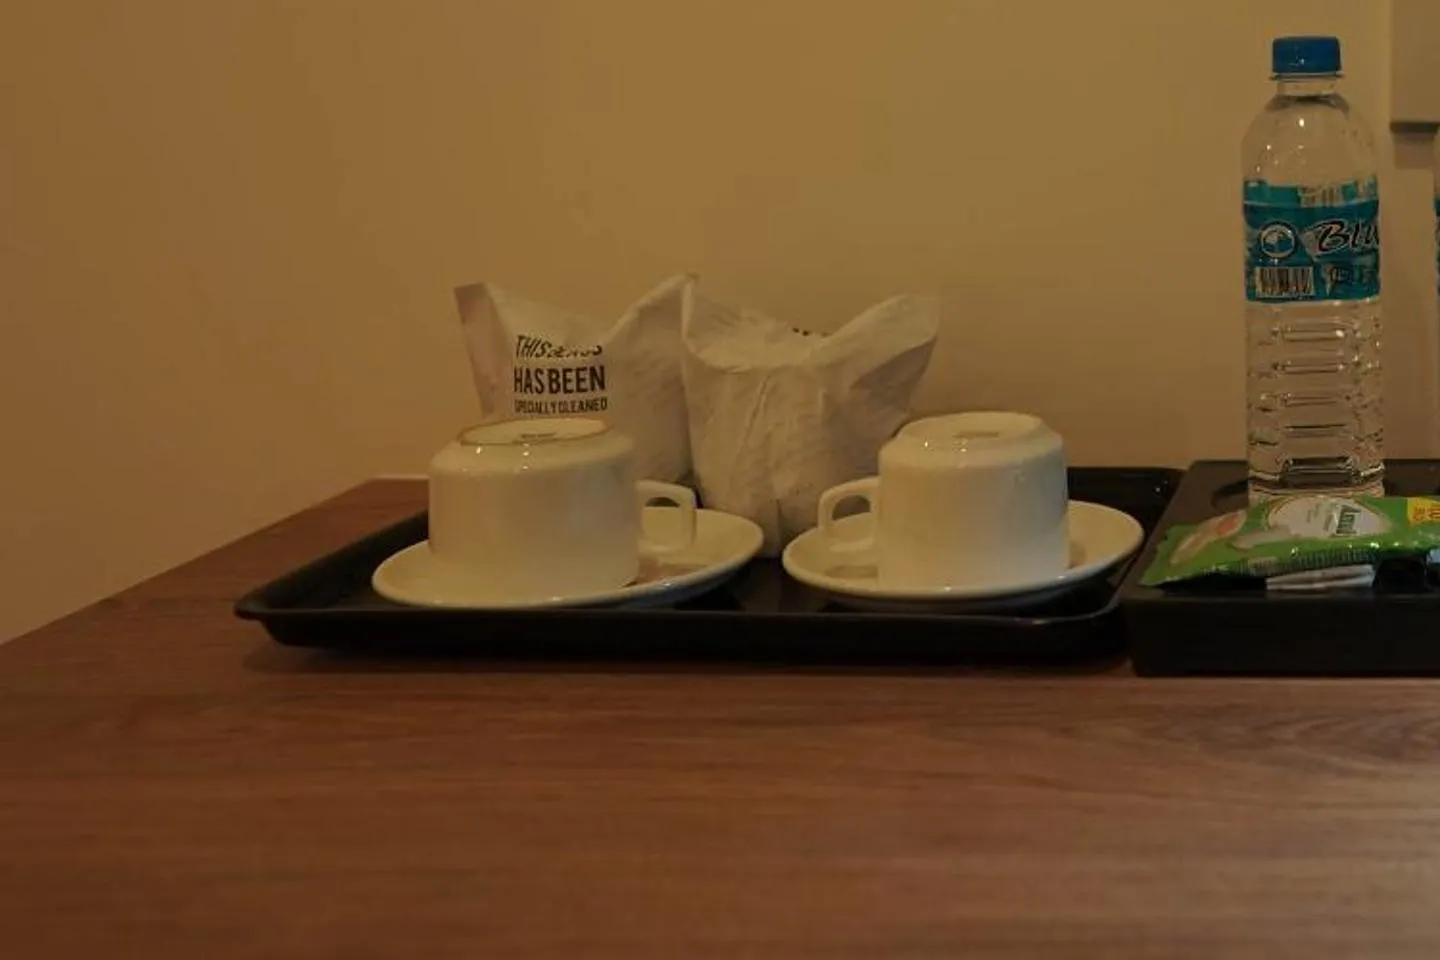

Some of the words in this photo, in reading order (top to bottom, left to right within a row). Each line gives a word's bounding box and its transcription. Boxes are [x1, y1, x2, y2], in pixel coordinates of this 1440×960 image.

[516, 335, 552, 358] THIS
[514, 367, 544, 394] HAS
[547, 365, 606, 394] BEEN
